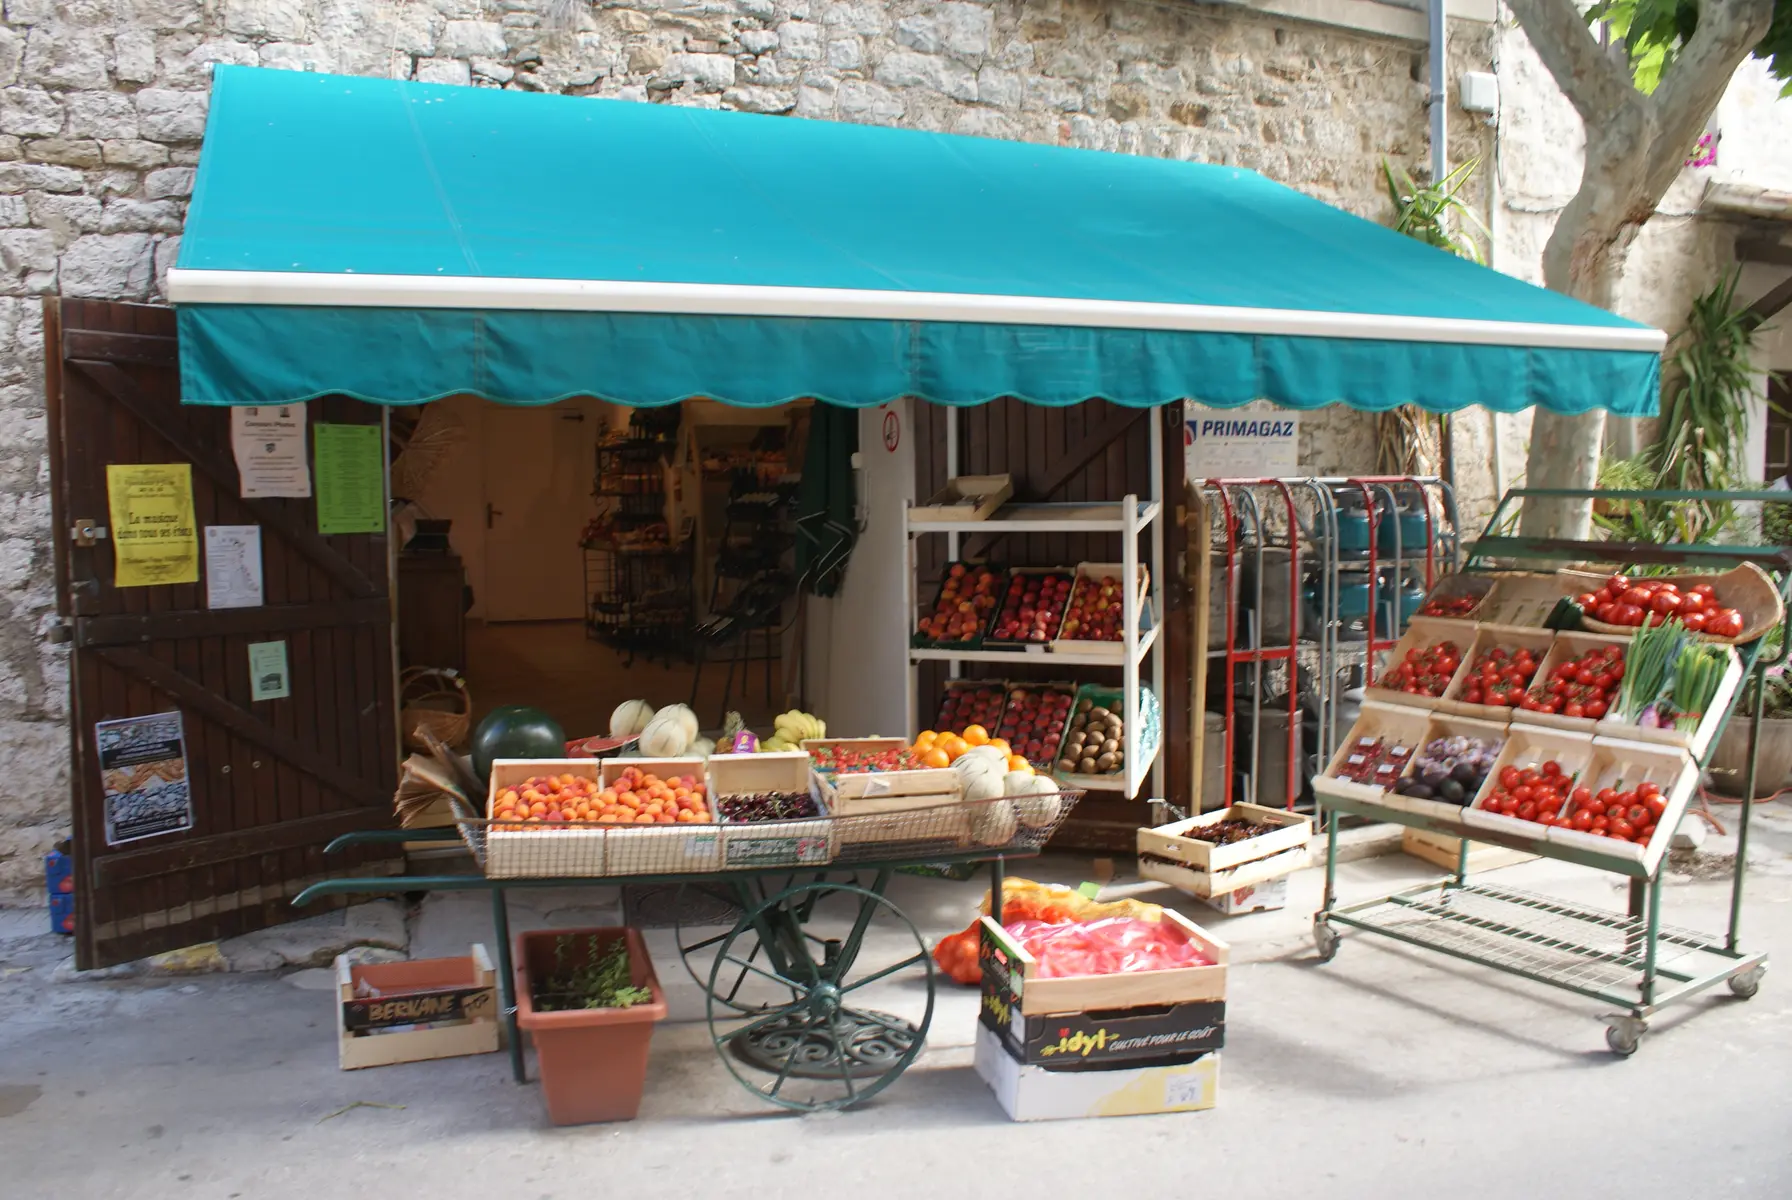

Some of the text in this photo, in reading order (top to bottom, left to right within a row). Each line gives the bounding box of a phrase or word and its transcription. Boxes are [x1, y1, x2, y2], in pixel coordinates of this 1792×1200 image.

[1202, 420, 1294, 437] PRIMAGAZ
[1058, 1027, 1106, 1057] idyl
[1148, 1032, 1177, 1047] POUR
[1175, 1030, 1190, 1042] LE
